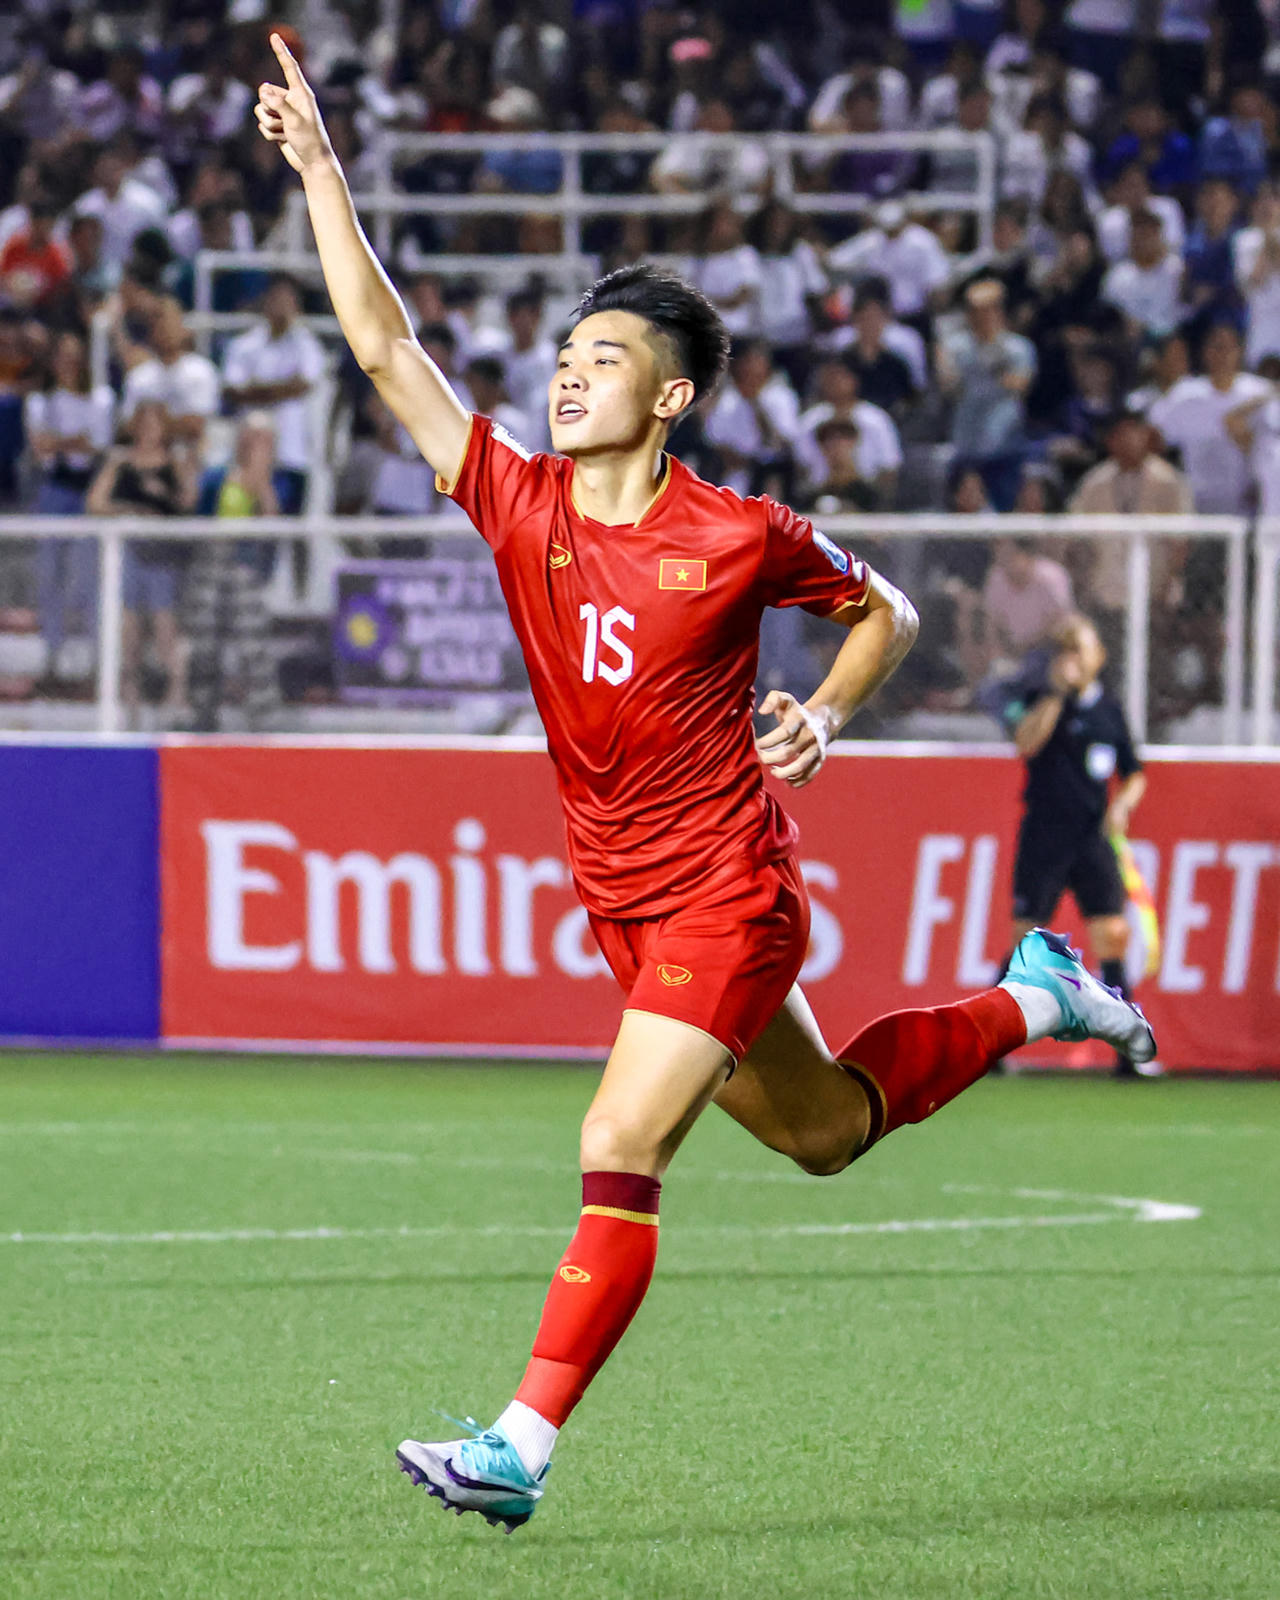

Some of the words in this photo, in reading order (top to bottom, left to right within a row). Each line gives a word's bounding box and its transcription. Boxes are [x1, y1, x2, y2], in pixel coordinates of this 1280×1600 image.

[579, 601, 635, 686] 15
[201, 818, 843, 983] Emirs
[902, 834, 1001, 987] FL
